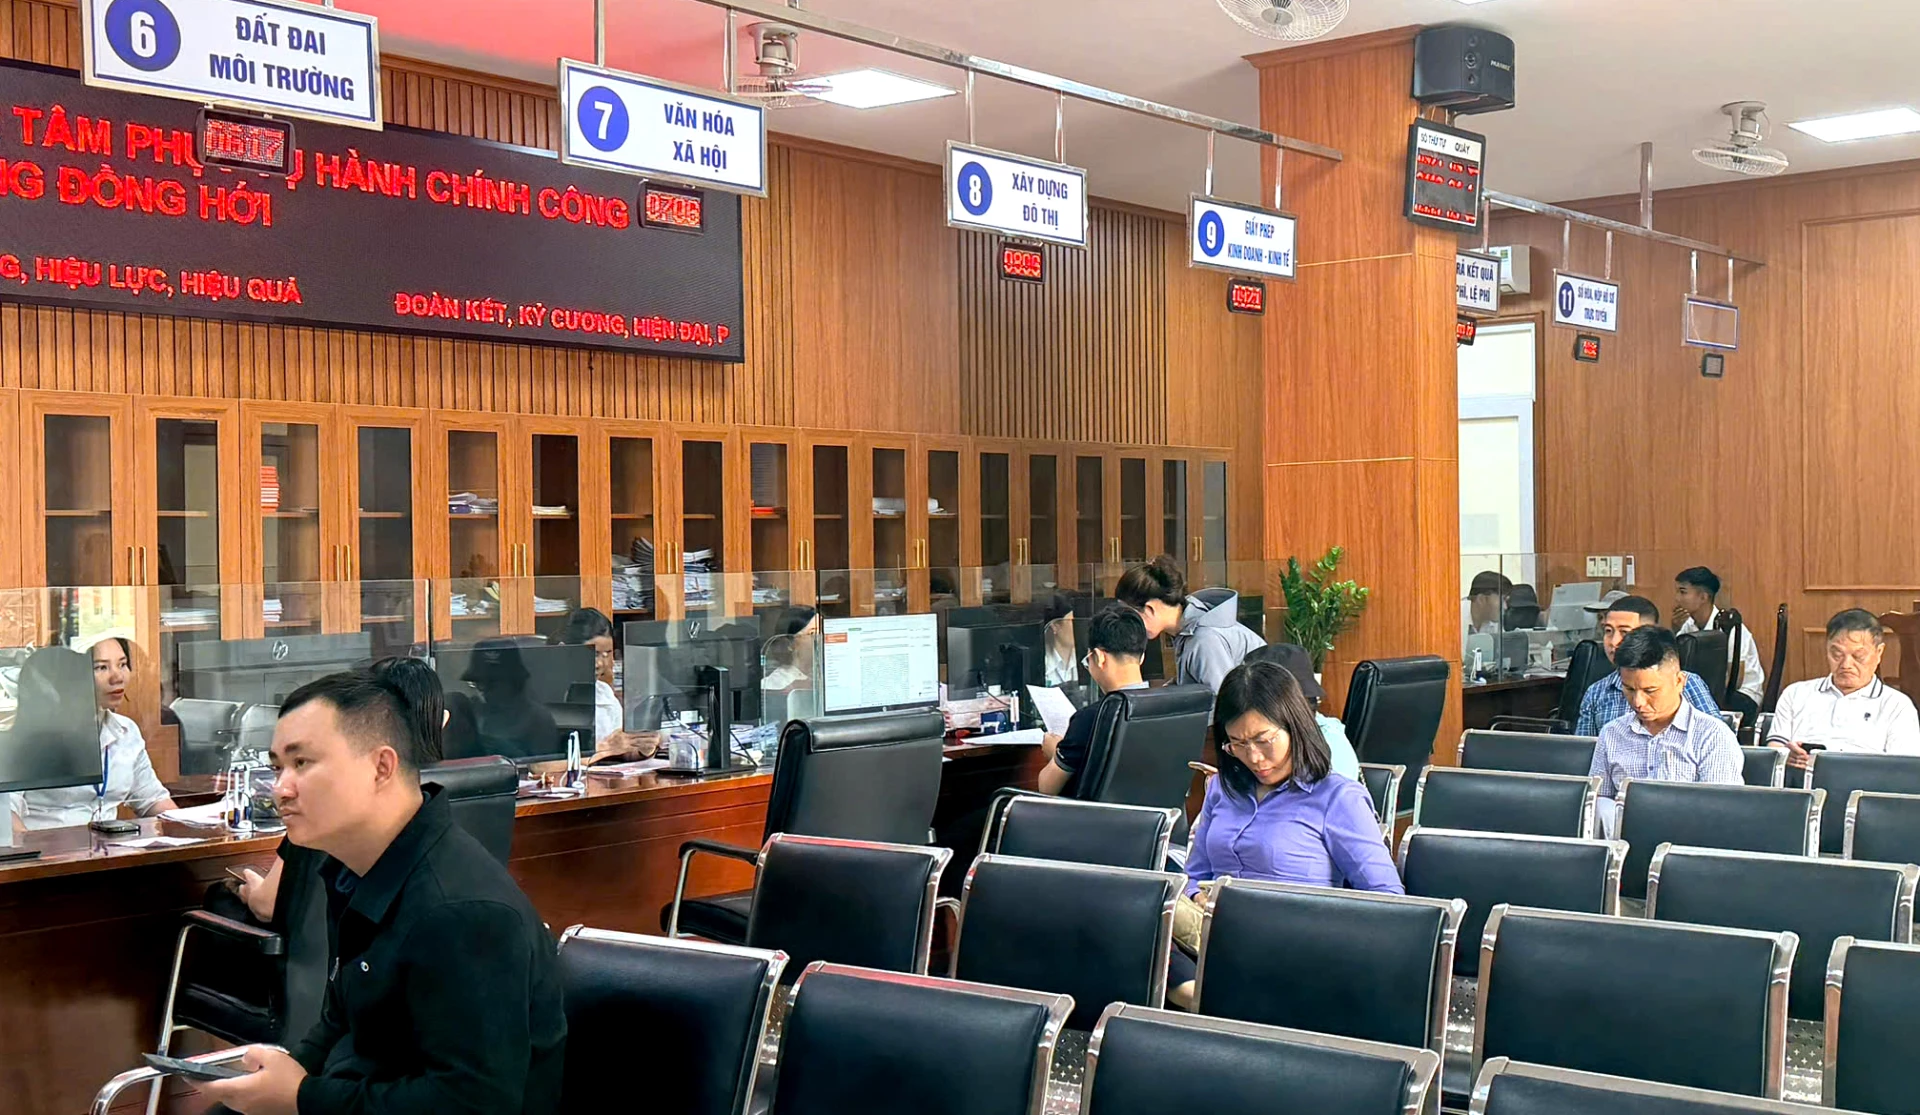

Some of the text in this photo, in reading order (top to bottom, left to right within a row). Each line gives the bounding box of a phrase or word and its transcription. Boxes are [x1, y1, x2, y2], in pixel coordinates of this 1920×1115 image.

[130, 11, 157, 58] 6
[235, 12, 326, 56] ĐẤT ĐAI
[209, 53, 355, 102] MÔI TRƯỜNG
[594, 101, 613, 141] 7
[664, 101, 735, 137] VĂN HÓA
[12, 104, 112, 157] TÂM
[126, 123, 205, 177] PHỤ
[315, 148, 417, 199] HÀNH
[426, 169, 531, 216] CHÍNH
[538, 184, 631, 230] CÔNG
[673, 139, 727, 173] XÃ HỘI
[56, 163, 187, 216] ĐỒNG
[199, 180, 272, 227] HỚI
[968, 174, 983, 207] 8
[1012, 171, 1068, 200] XÂY DỰNG
[1023, 203, 1058, 230] ĐÔ THỊ
[1206, 220, 1217, 250] 9
[35, 255, 101, 290] HIỆU
[109, 264, 174, 299] LỰC,
[181, 270, 241, 301] HIỆU
[247, 276, 303, 304] QUẢ
[1467, 262, 1479, 279] KẾT
[1480, 264, 1493, 281] QUẢ
[395, 291, 461, 320] ĐOÀN
[465, 297, 514, 329] KẾT,
[550, 307, 630, 340] CƯƠNG,
[633, 316, 675, 343] HIỆN
[678, 321, 715, 347] ĐẠI,
[717, 323, 730, 345] P
[1562, 289, 1573, 312] 11
